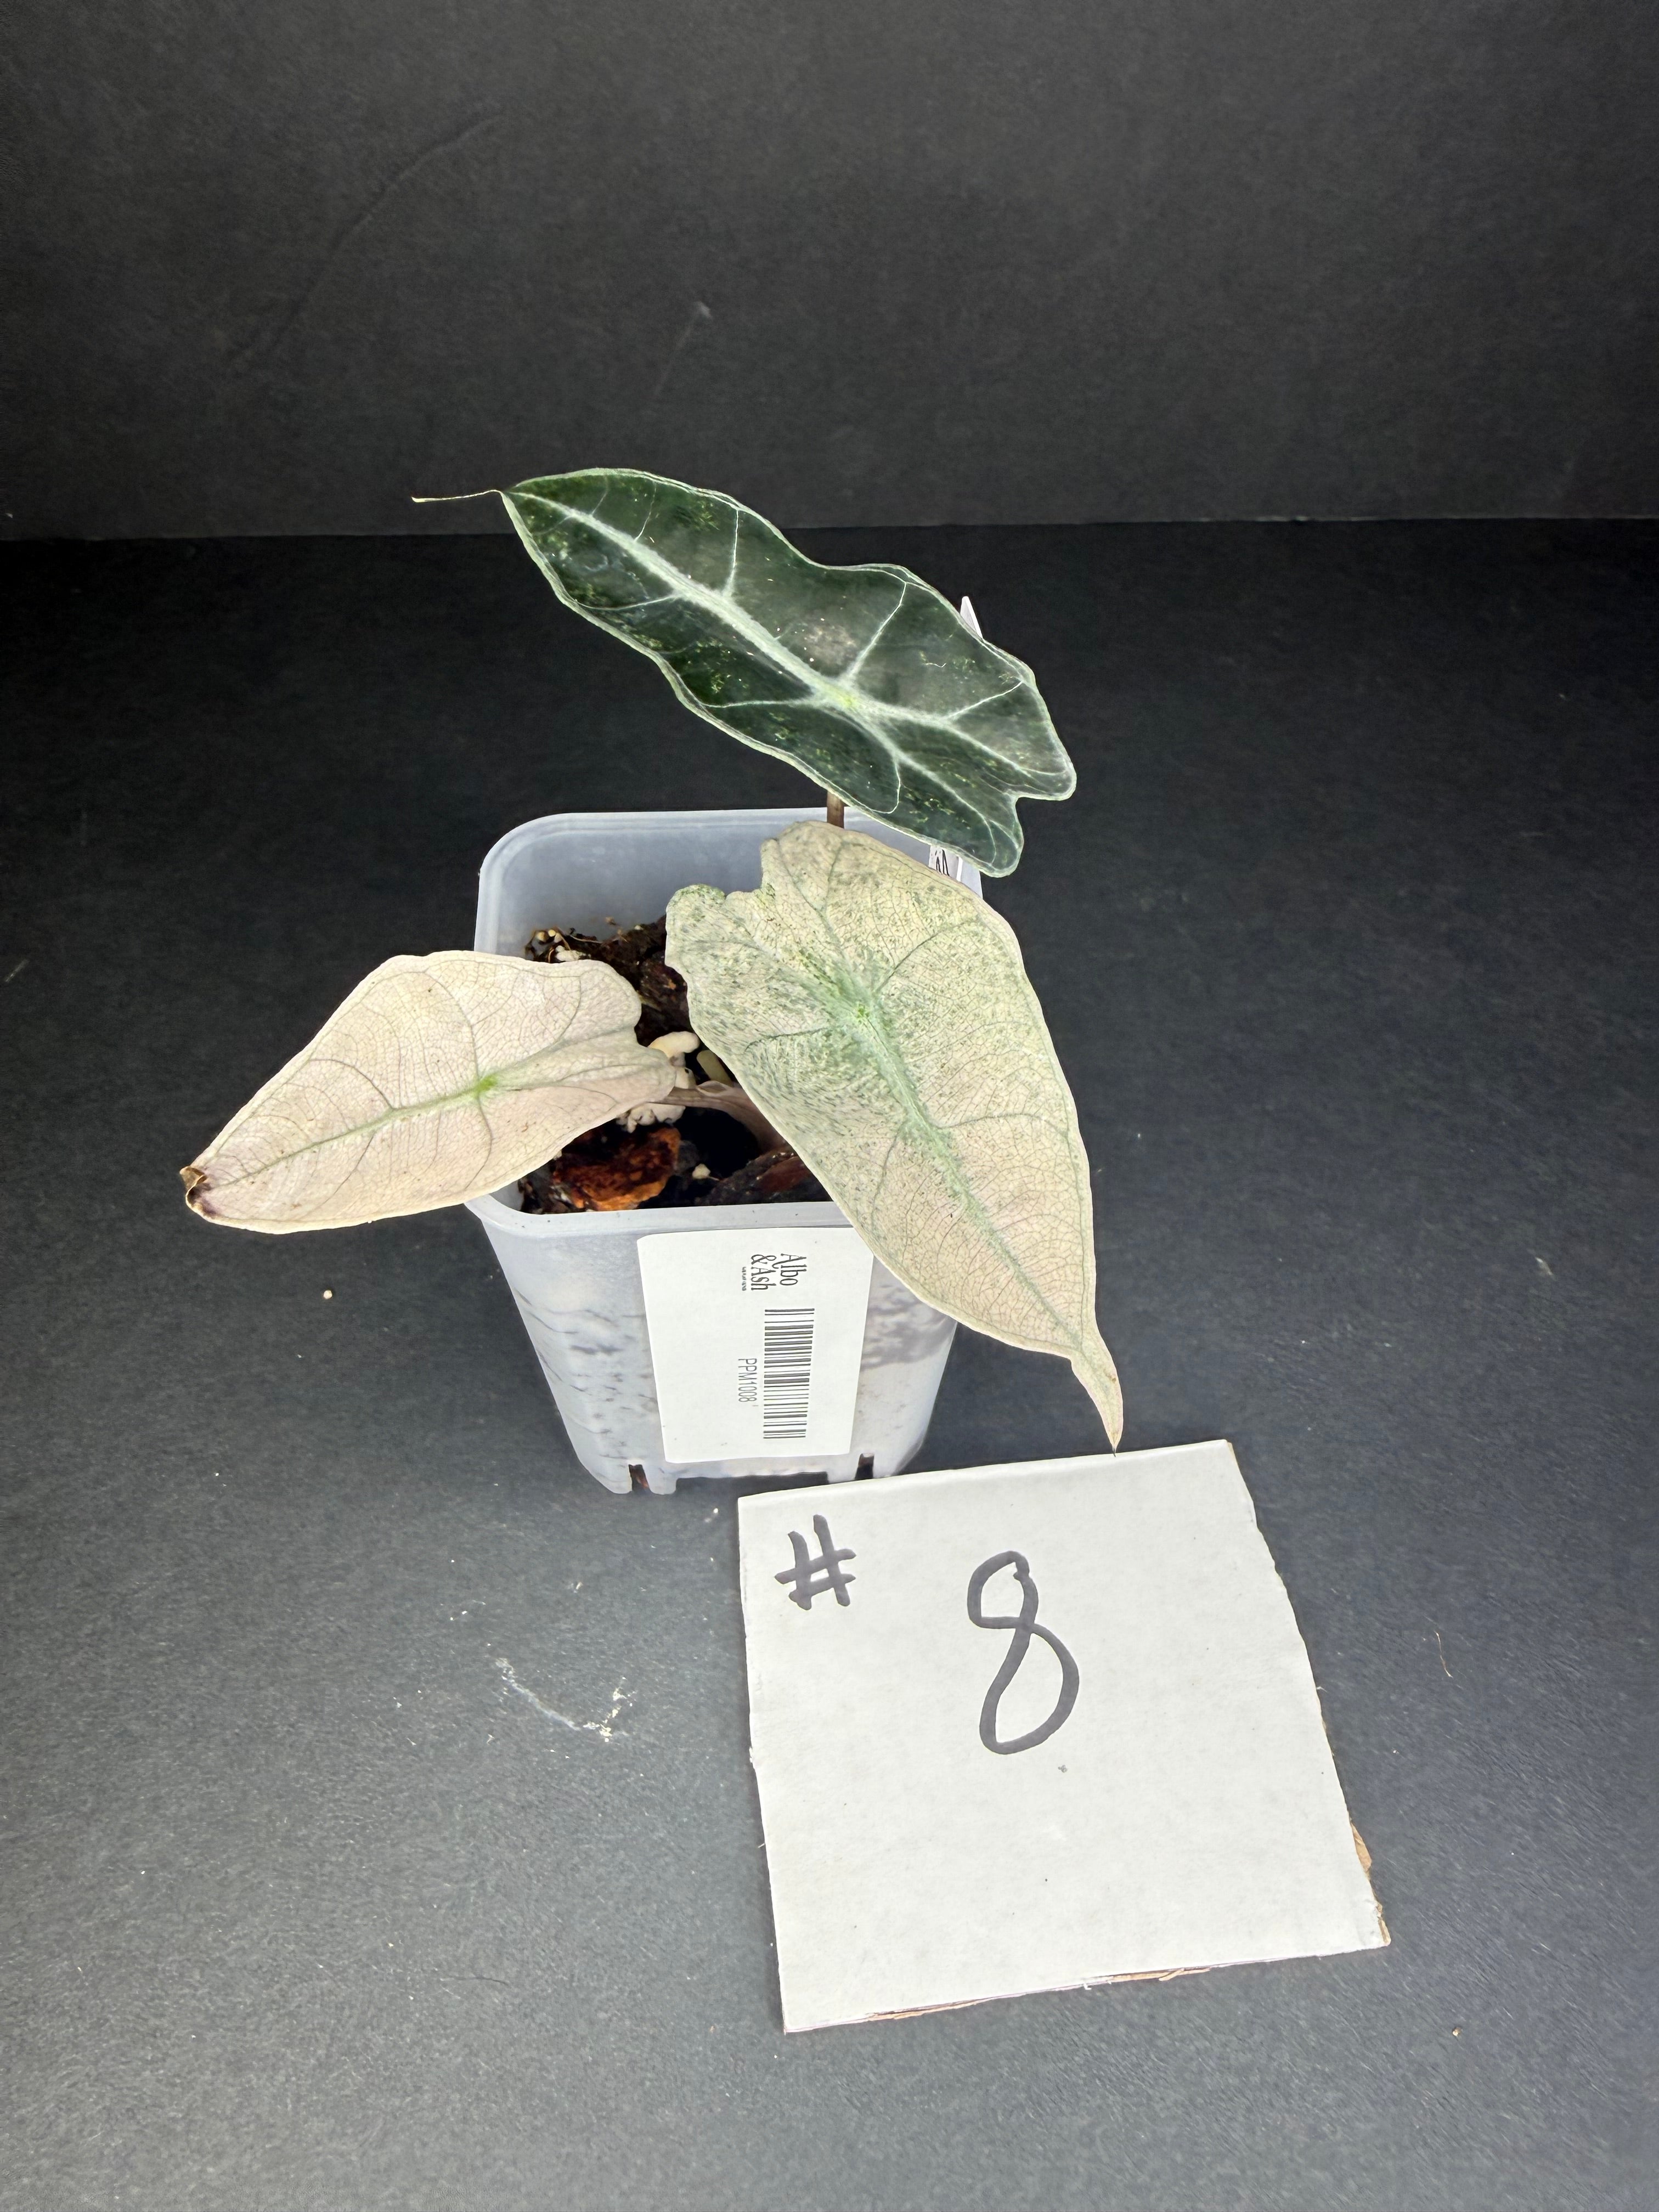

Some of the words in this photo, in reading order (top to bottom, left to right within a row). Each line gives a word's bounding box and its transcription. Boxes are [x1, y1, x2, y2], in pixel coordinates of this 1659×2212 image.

[772, 1253, 807, 1286] Albo
[738, 1358, 757, 1403] PPM1008
[775, 1514, 856, 1610] #
[967, 1550, 1080, 1755] 8
